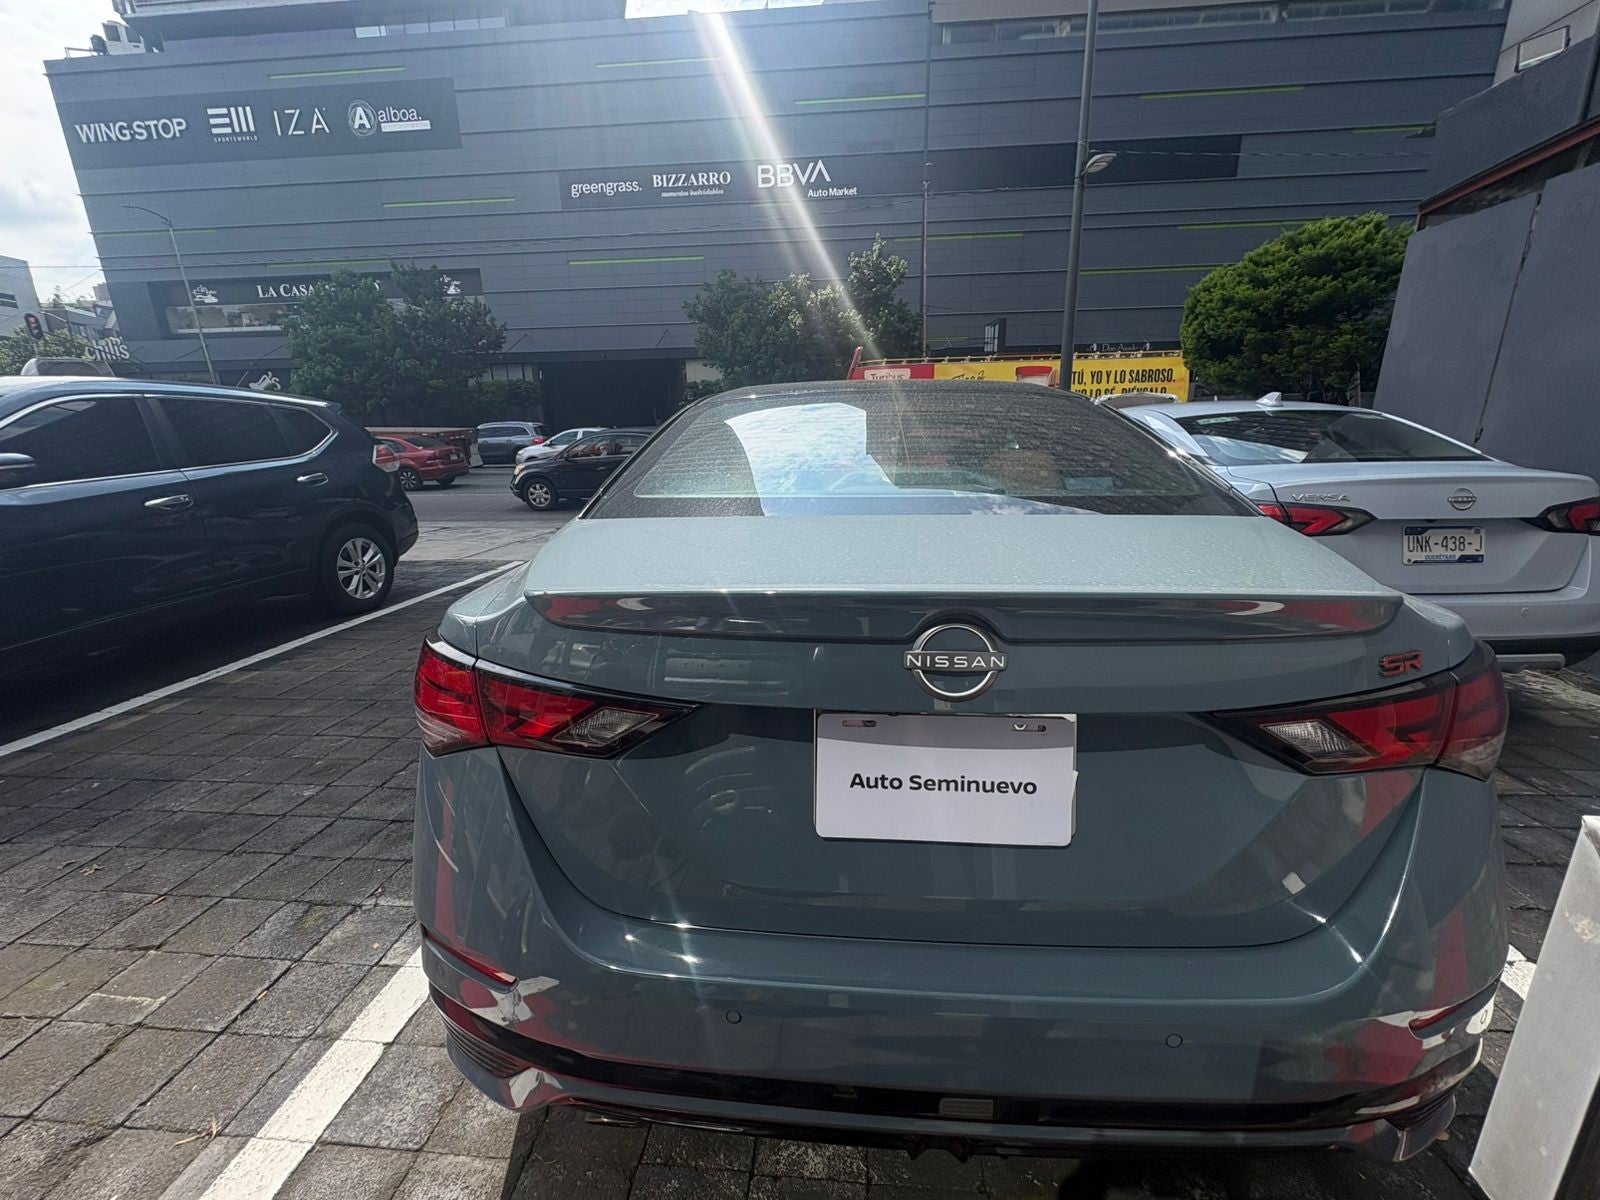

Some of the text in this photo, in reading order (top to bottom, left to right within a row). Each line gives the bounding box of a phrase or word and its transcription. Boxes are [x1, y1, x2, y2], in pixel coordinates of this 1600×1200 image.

[652, 171, 731, 188] BIZZARRO
[757, 159, 831, 188] BBVA
[571, 181, 643, 198] greengrass.
[807, 187, 857, 197] Auto Market
[256, 284, 278, 298] LA
[279, 283, 315, 298] CASA
[1071, 368, 1176, 386] TÚ, YO Y LO SABROSO.
[1291, 494, 1350, 502] VERSA
[1407, 535, 1483, 552] UNK-438-J
[906, 654, 1005, 669] NISSAN
[1380, 650, 1424, 677] SR
[850, 773, 1038, 795] Auto Seminuevo
